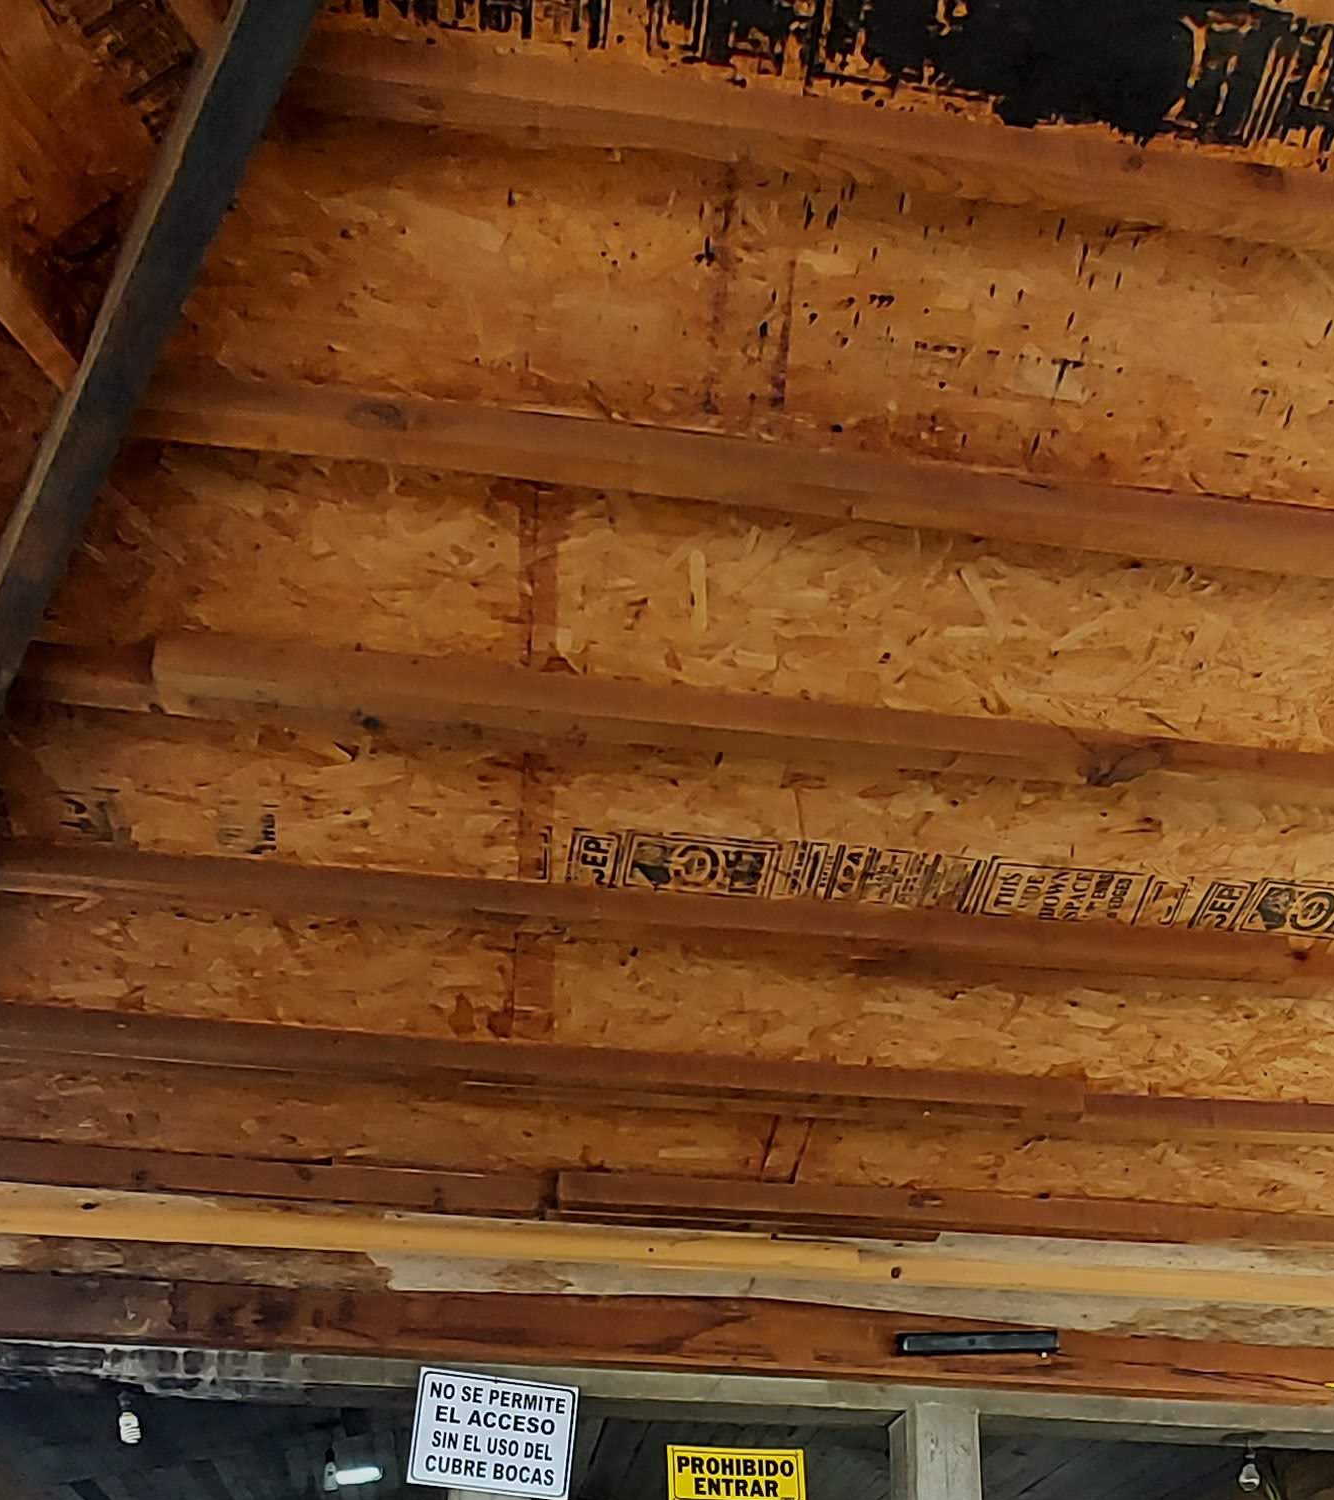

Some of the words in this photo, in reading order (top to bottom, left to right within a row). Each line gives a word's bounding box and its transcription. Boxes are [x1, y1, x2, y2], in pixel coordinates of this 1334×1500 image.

[430, 1382, 455, 1400] NO
[461, 1386, 483, 1404] SE
[489, 1389, 566, 1414] PERMITE
[435, 1405, 461, 1424] EL
[467, 1410, 555, 1435] ACCESO
[431, 1430, 459, 1450] SIN
[463, 1434, 481, 1452] EL
[487, 1437, 519, 1457] USO
[524, 1441, 553, 1461] DEL
[425, 1455, 487, 1478] CUBRE
[493, 1463, 555, 1486] BOCAS
[676, 1455, 795, 1477] PROHIBIDO
[694, 1477, 779, 1497] ENTRAR
